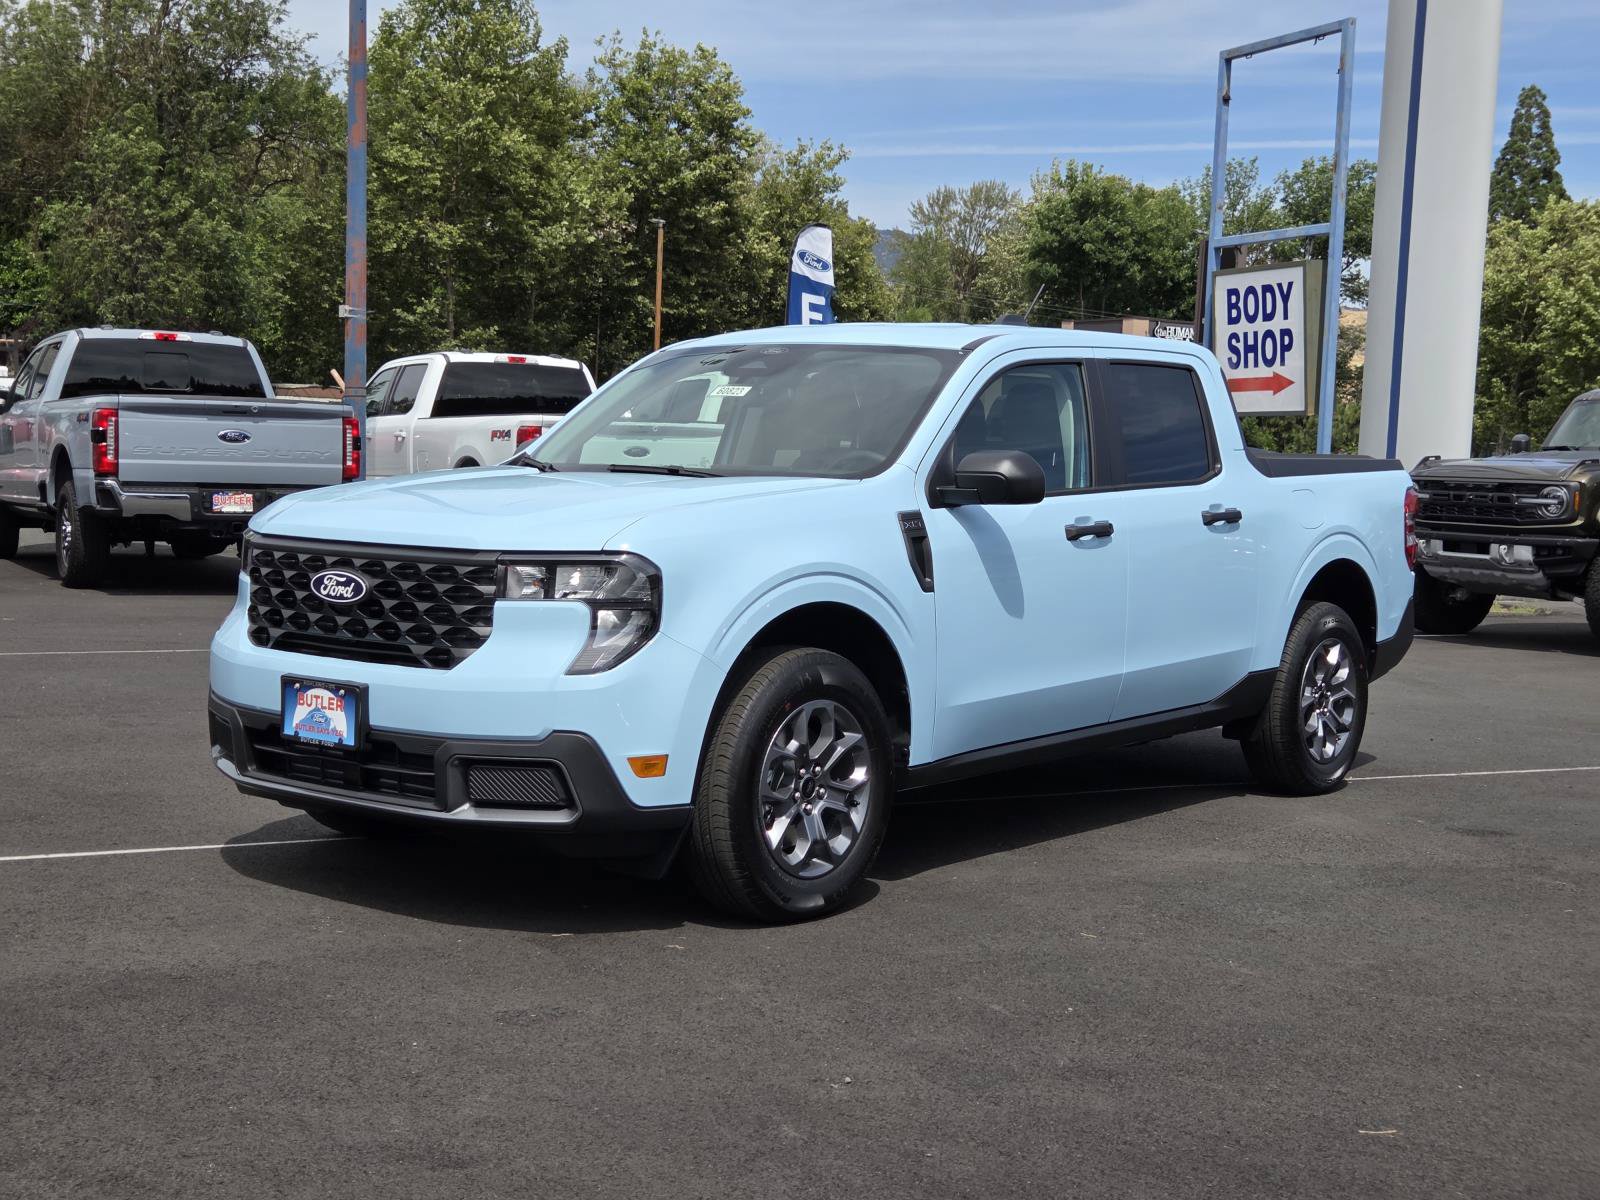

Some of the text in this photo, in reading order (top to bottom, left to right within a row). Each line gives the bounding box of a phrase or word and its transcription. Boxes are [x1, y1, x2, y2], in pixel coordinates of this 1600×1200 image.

[804, 252, 823, 270] Ford
[1227, 281, 1294, 325] BODY
[1227, 328, 1294, 370] SHOP
[491, 429, 512, 441] FX4
[131, 445, 332, 459] SUPER DUTY
[213, 496, 253, 505] BUTLER
[320, 574, 356, 598] Ford
[297, 691, 345, 712] BUTLER
